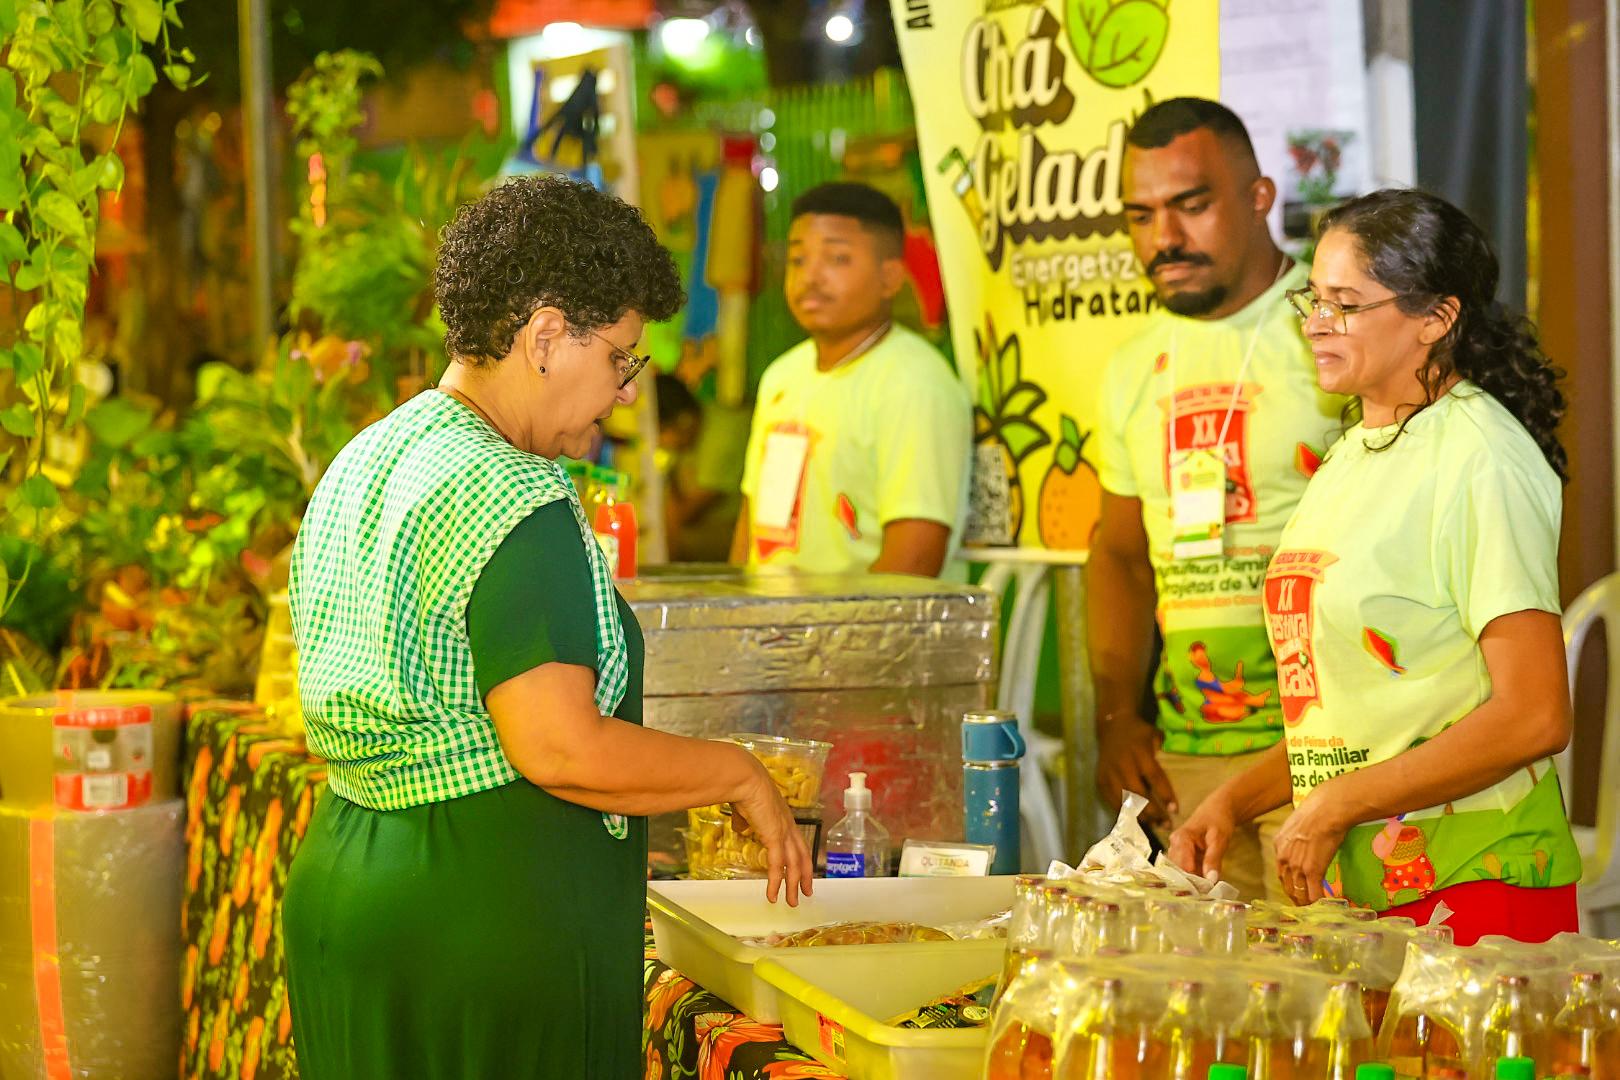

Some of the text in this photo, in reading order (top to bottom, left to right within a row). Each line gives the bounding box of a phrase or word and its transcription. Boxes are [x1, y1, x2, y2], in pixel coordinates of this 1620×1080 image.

[961, 6, 1066, 122] Chá
[975, 121, 1125, 252] Gelad
[1022, 280, 1160, 326] Hidratan
[1191, 412, 1218, 446] XX
[1277, 578, 1297, 611] XX
[1307, 747, 1370, 766] Familiar
